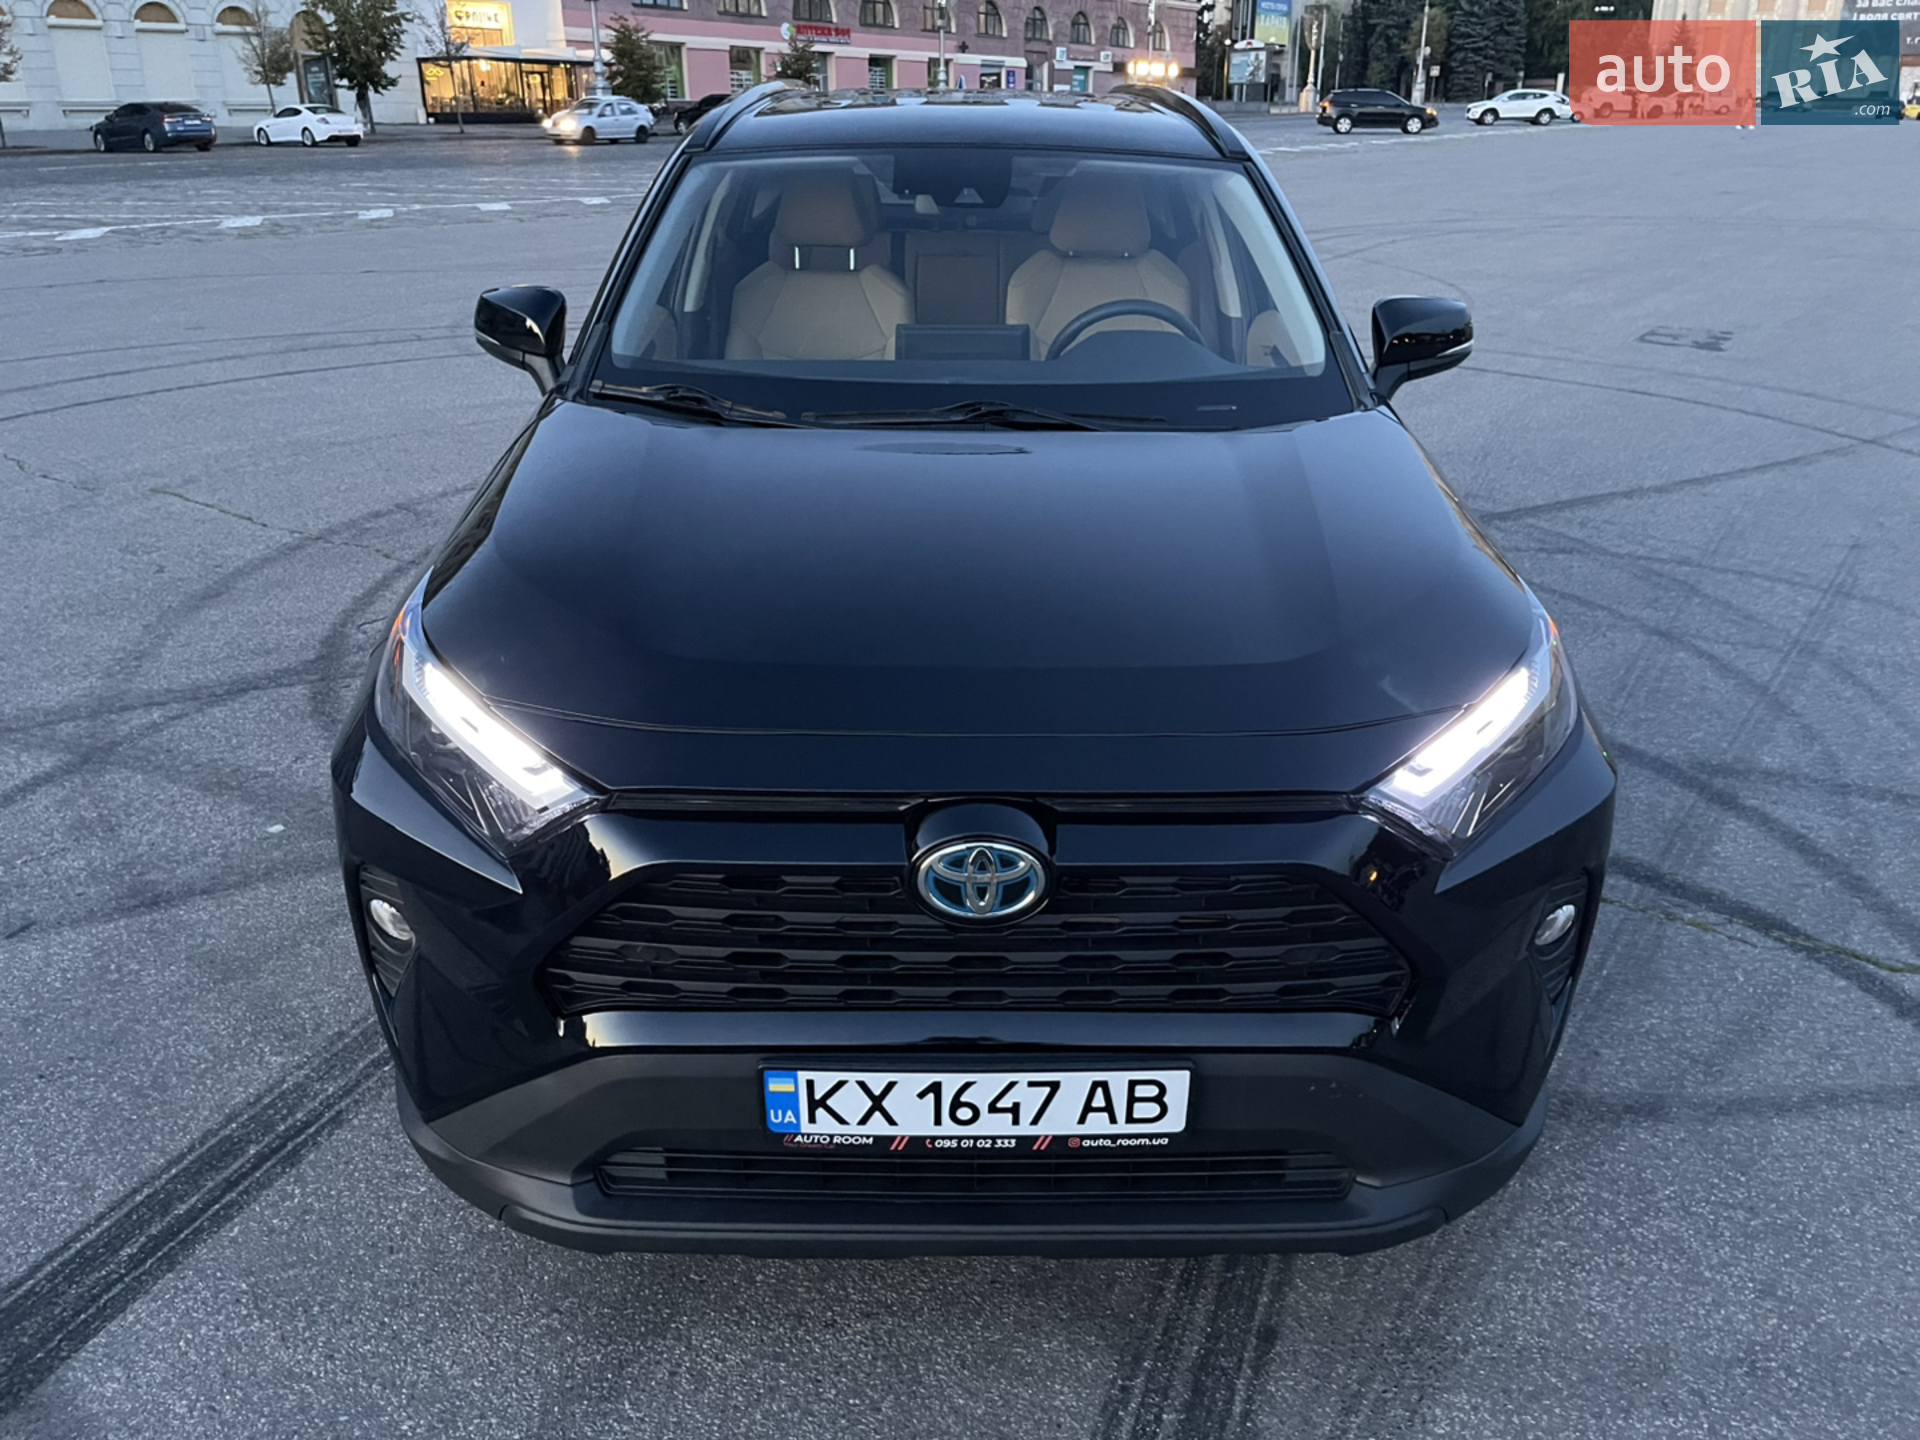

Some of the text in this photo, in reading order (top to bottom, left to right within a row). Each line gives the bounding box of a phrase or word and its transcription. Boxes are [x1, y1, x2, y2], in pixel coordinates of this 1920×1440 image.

[805, 1078, 1168, 1127] KX 1647 AB
[770, 1109, 797, 1124] UA
[794, 1135, 874, 1145] AUTO ROOM
[934, 1138, 1017, 1148] 095 01 02 333
[1081, 1137, 1169, 1148] auto_room.ua
